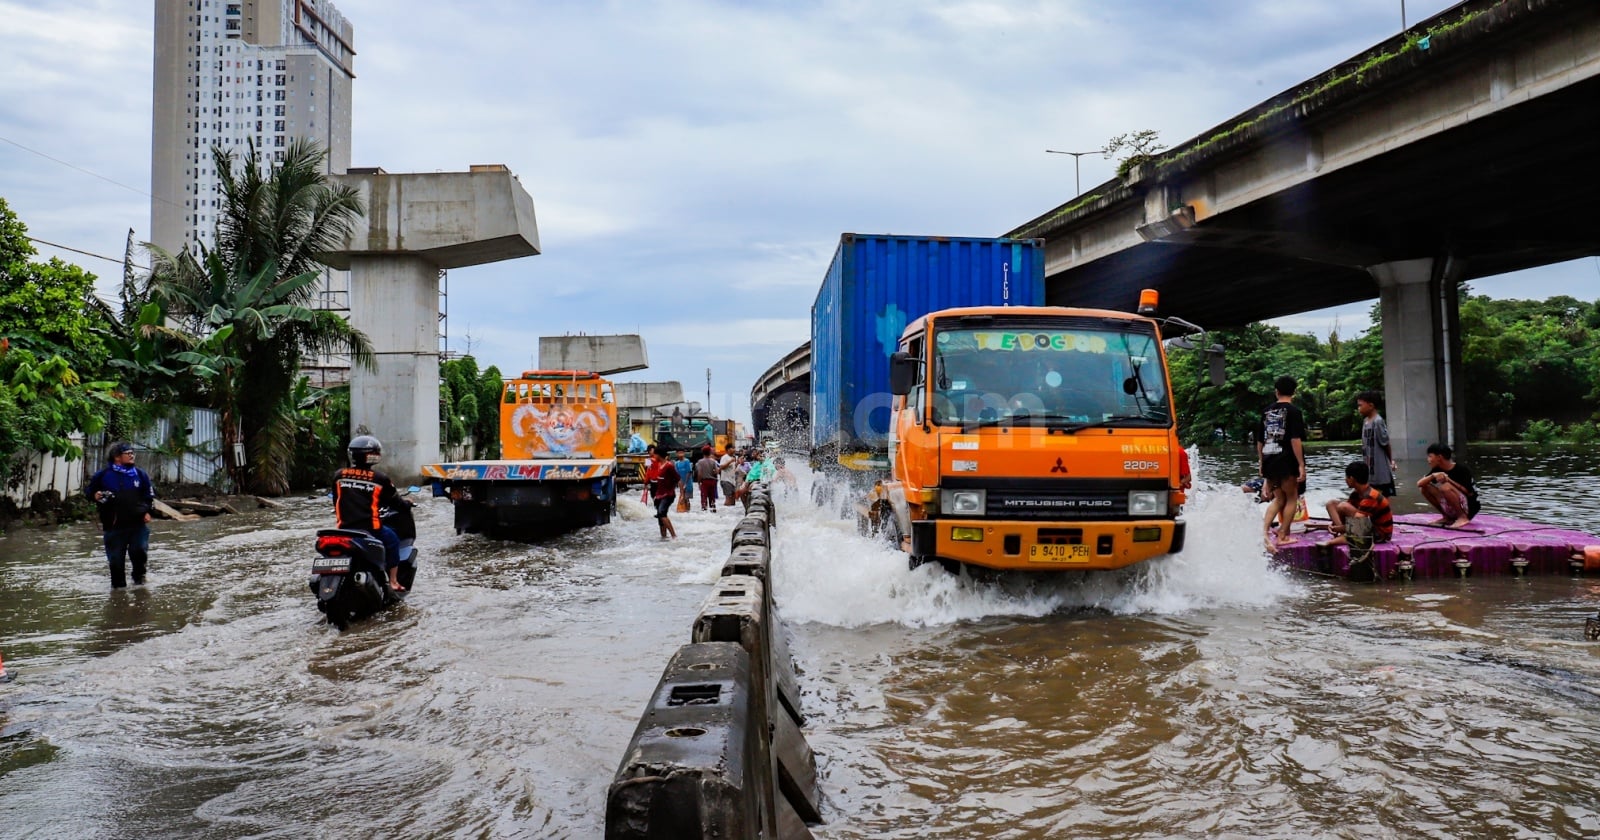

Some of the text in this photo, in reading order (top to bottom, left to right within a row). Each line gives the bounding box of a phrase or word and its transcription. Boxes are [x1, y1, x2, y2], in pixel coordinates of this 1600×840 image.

[1017, 332, 1107, 354] DOCTOR
[1123, 460, 1159, 470] 220PS
[1031, 545, 1089, 556] B 9410 PEH
